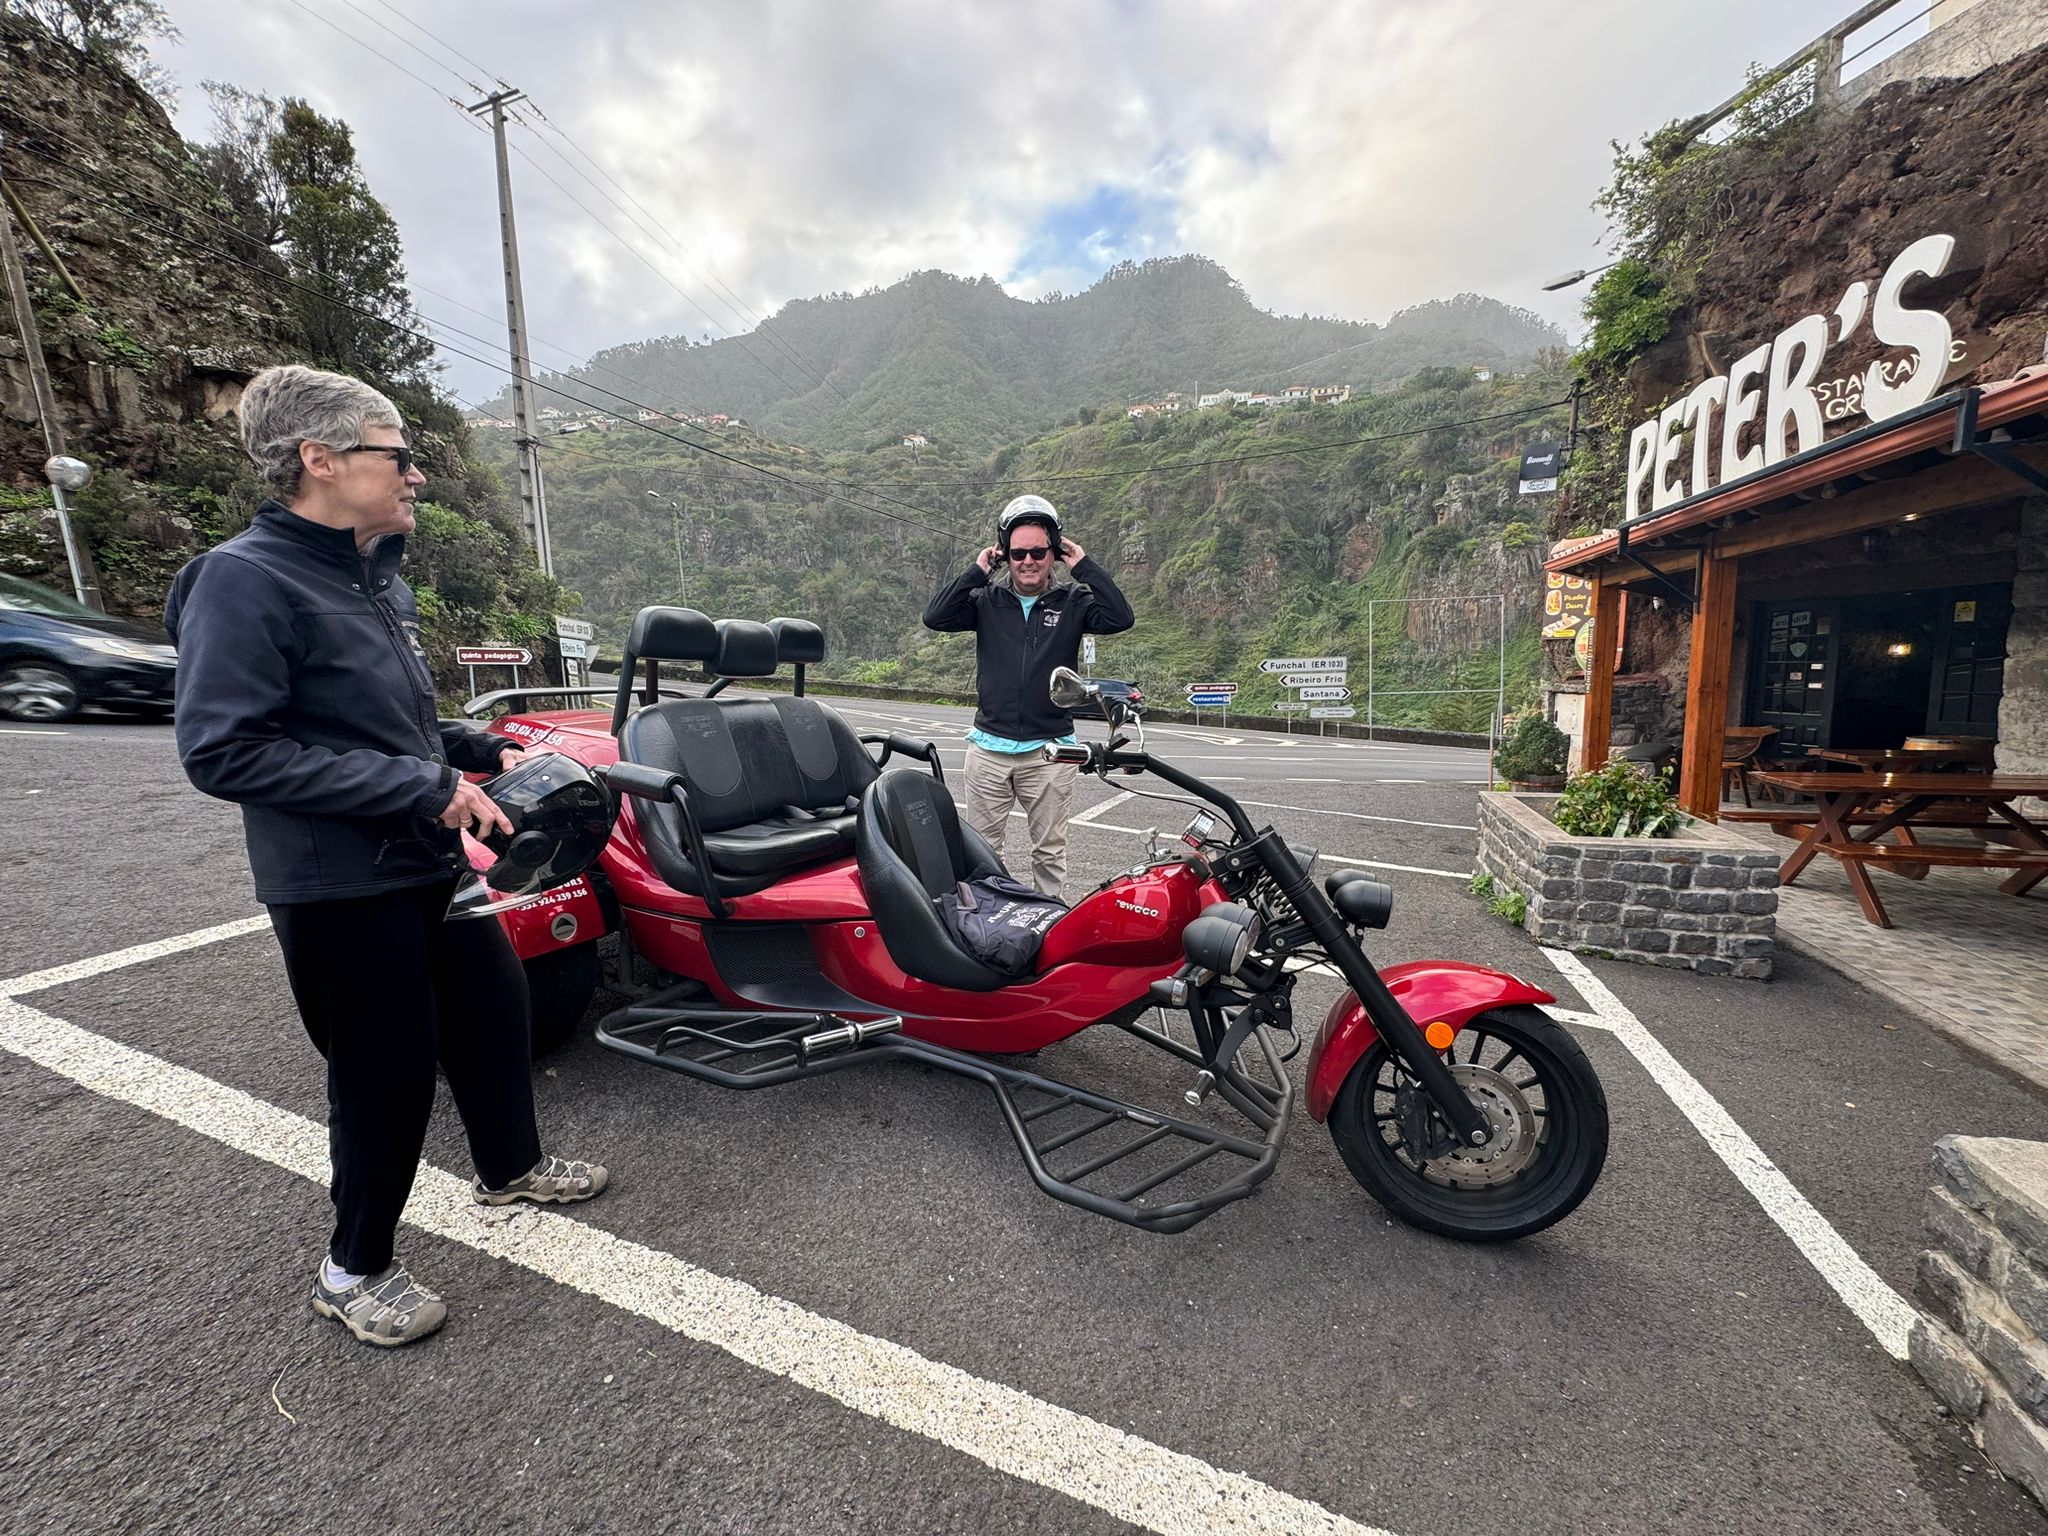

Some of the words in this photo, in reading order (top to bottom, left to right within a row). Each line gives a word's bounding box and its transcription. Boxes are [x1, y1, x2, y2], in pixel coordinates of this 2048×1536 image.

[1626, 234, 1955, 522] PETER'S
[461, 652, 482, 660] quinta
[1270, 661, 1306, 669] Funchal
[1311, 660, 1326, 669] (ER
[1328, 659, 1344, 668] 103)
[1290, 676, 1322, 684] Ribeiro
[1325, 675, 1343, 683] Frio
[1303, 690, 1340, 698] Santana
[556, 892, 571, 901] 239
[572, 888, 587, 897] 156
[1116, 900, 1159, 917] rewaco
